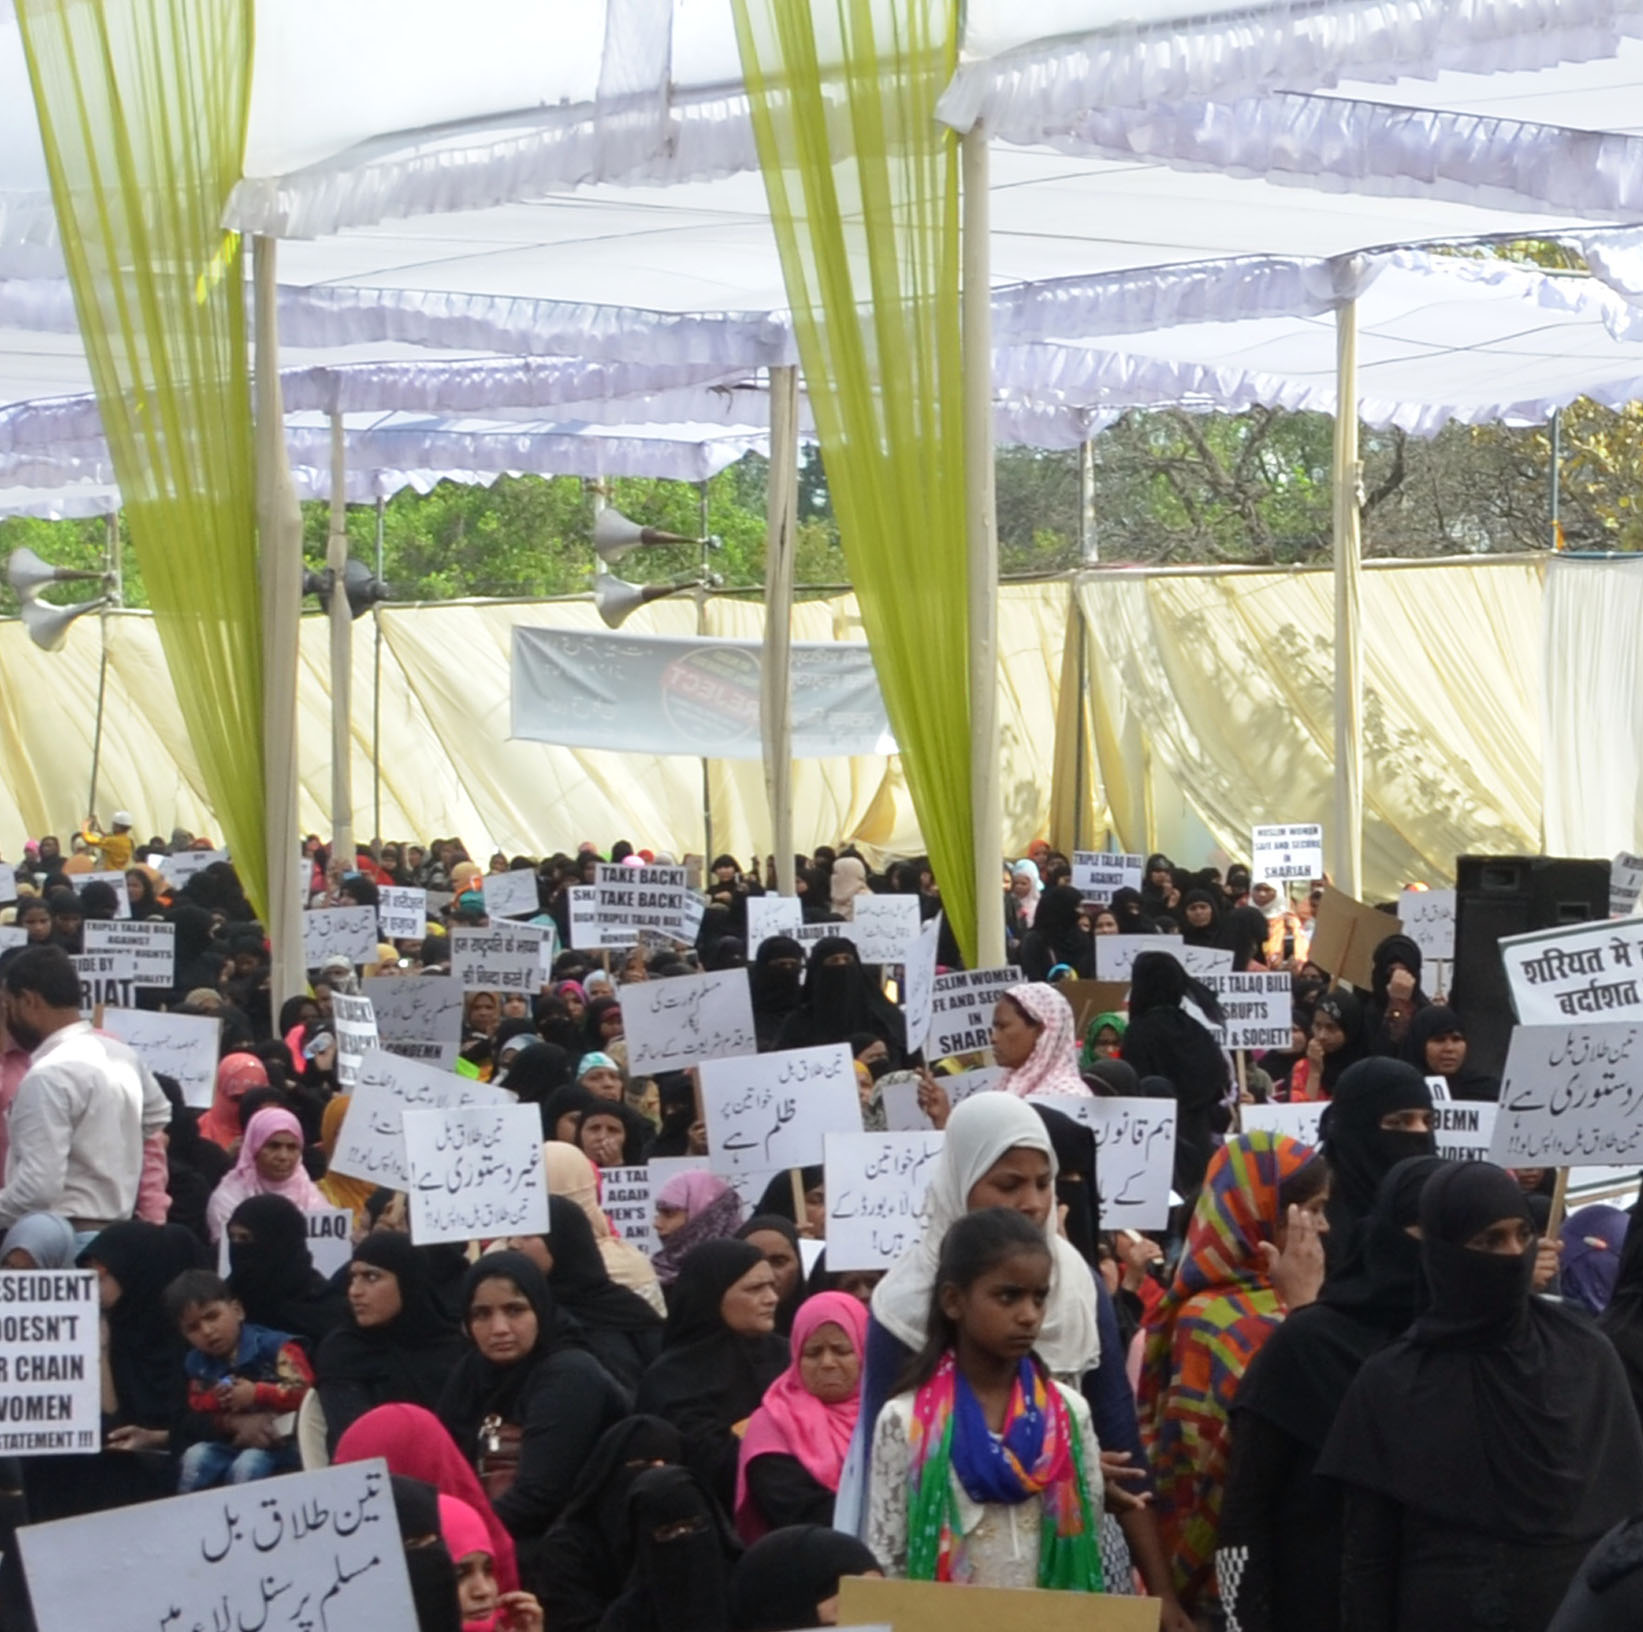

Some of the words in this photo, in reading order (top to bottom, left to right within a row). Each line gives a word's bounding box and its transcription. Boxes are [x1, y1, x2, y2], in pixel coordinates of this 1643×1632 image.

[601, 867, 636, 885] TAKE
[640, 868, 684, 886] BACK!
[600, 890, 634, 908] TAKE
[638, 892, 683, 909] BACK!
[598, 912, 628, 925] TRIPLE
[631, 914, 661, 927] TALAQ
[663, 915, 683, 928] BILL
[1520, 947, 1605, 984] शरियत
[968, 1012, 982, 1026] IN
[1243, 1028, 1291, 1046] SOCIETY
[15, 1354, 85, 1383] CHAIN
[334, 1472, 382, 1537] تین
[201, 1503, 244, 1562] بل
[253, 1499, 330, 1552] طلاق
